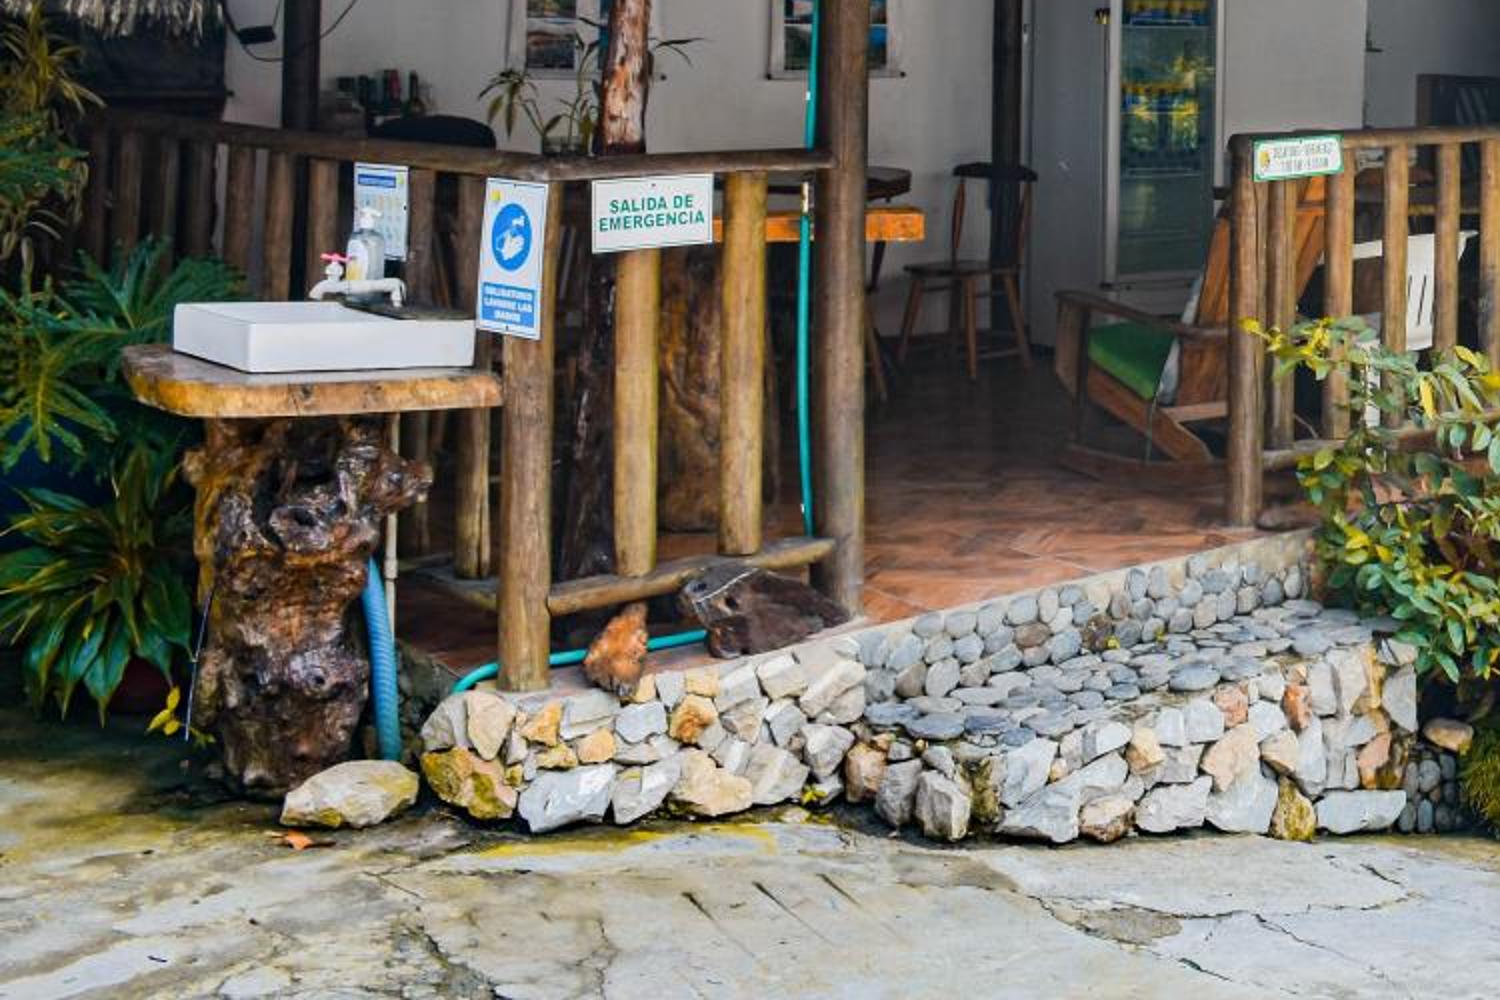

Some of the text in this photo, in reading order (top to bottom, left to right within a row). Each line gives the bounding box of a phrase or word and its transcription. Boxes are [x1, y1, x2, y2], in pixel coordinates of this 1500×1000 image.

[609, 194, 694, 214] SALIDA DE
[599, 210, 705, 232] EMERGENCIA
